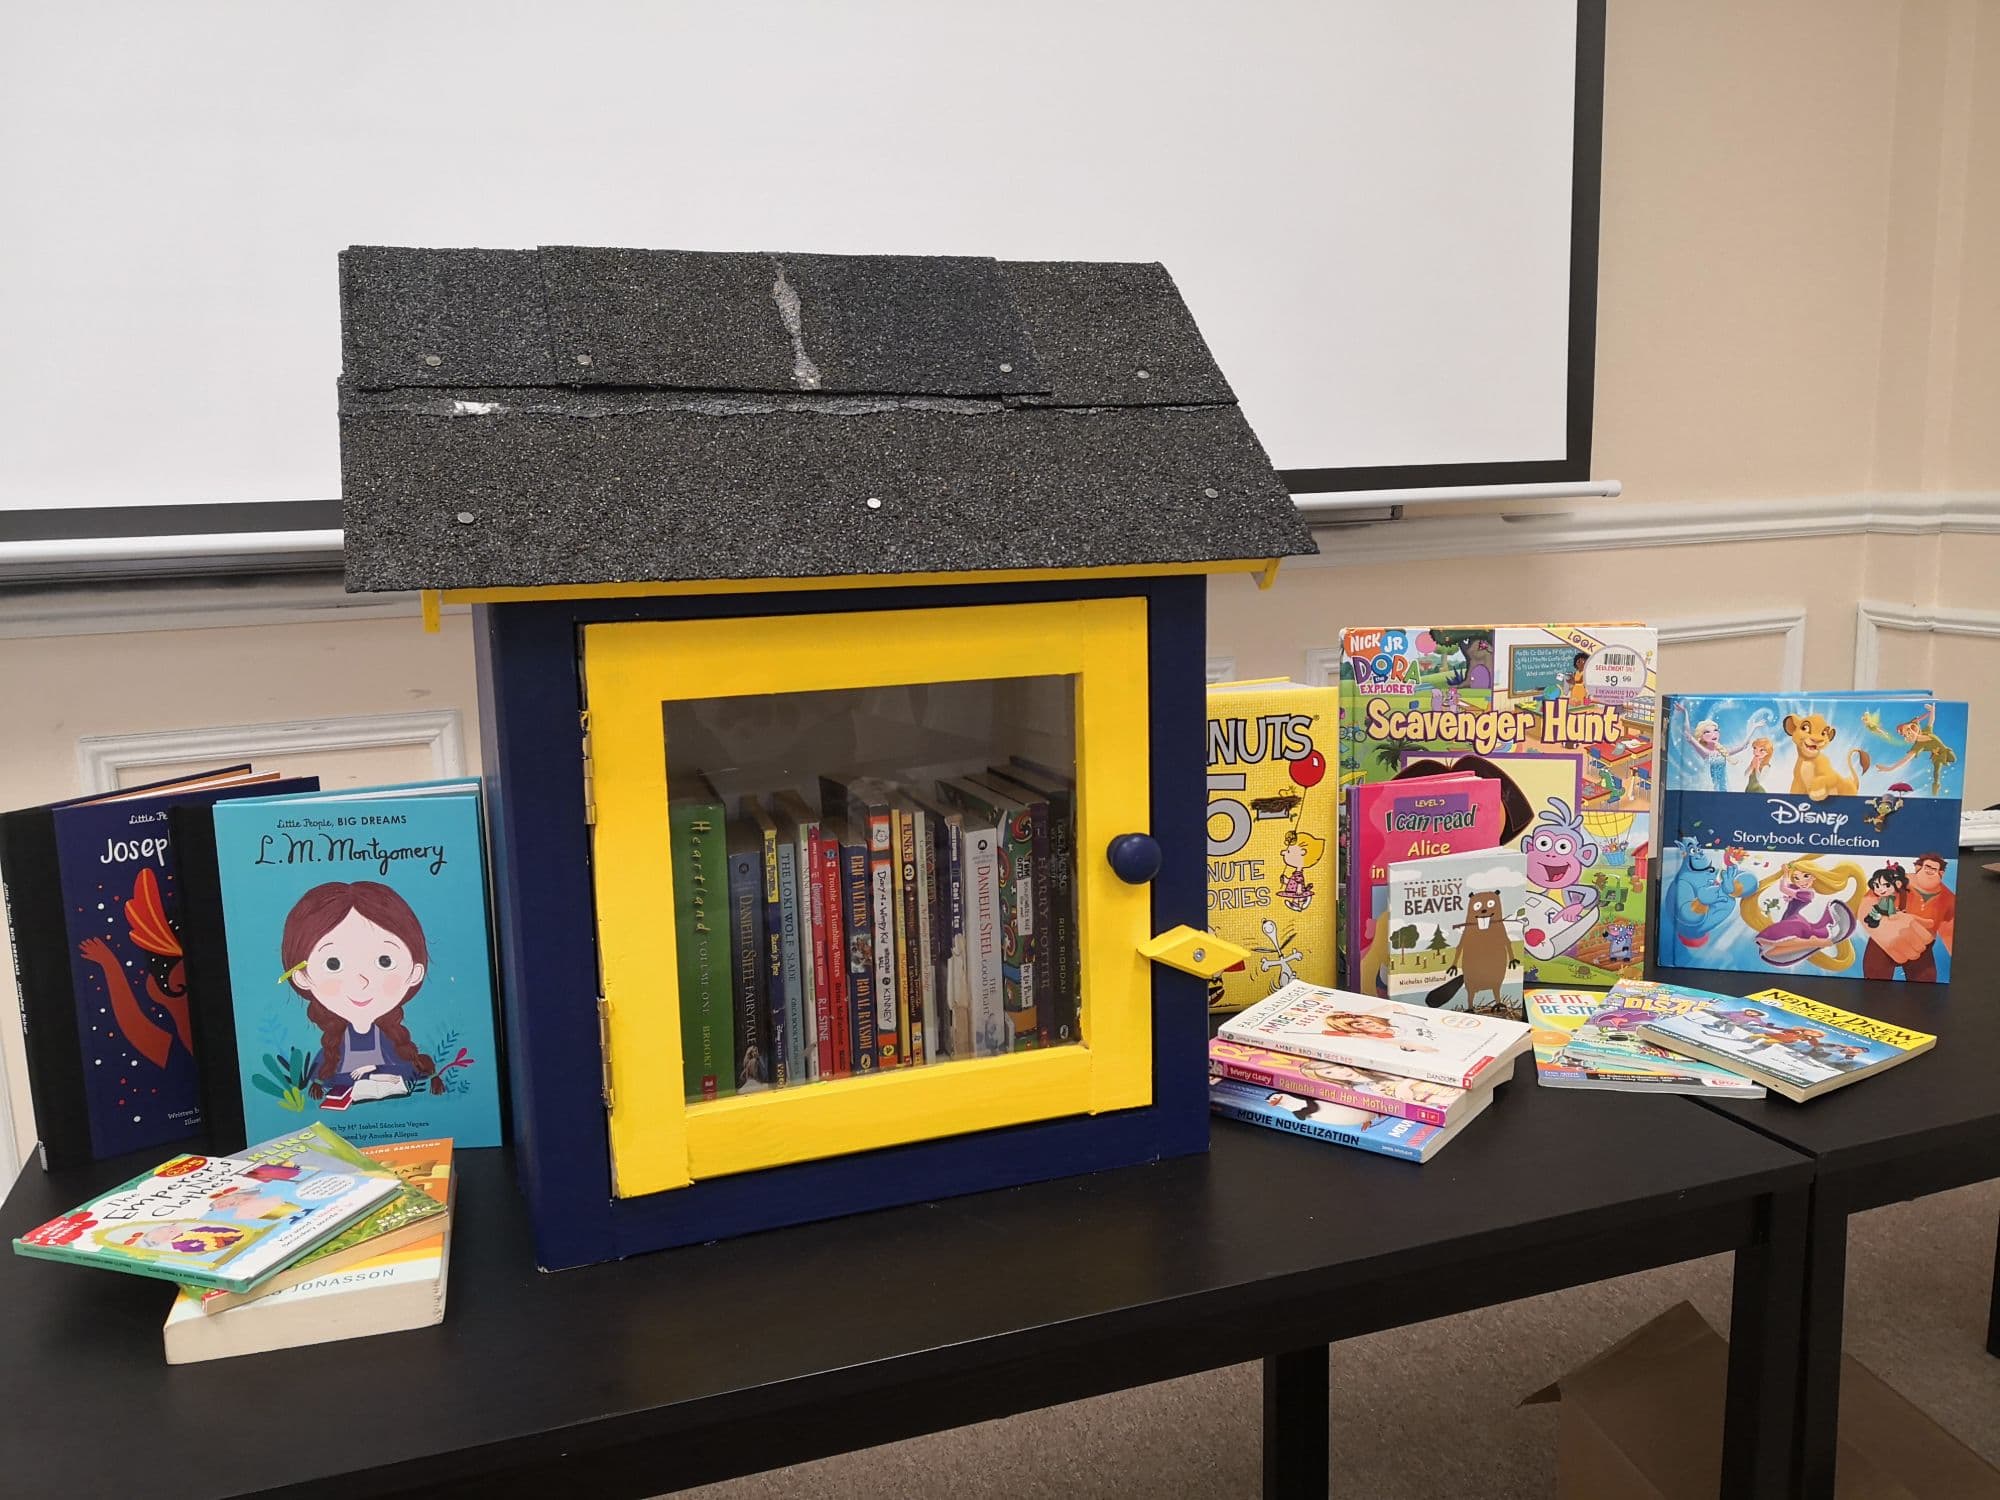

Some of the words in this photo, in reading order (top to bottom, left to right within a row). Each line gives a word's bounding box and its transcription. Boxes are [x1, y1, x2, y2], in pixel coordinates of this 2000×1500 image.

[1350, 633, 1381, 652] NICK
[1384, 636, 1404, 652] JR
[1567, 631, 1597, 652] LOOK
[1351, 653, 1421, 685] DORA
[1360, 684, 1414, 695] EXPLORER
[1207, 714, 1314, 766] NUTS
[1366, 697, 1536, 756] Scavenger
[1542, 698, 1623, 745] Hunt
[1385, 810, 1393, 832] I
[1396, 813, 1432, 832] can
[1433, 803, 1478, 833] read
[1415, 799, 1439, 808] LEVEL
[276, 819, 301, 829] Little
[303, 818, 335, 830] People,
[337, 817, 357, 826] BIG
[361, 815, 407, 825] DREAMS
[100, 838, 169, 867] Josep
[903, 823, 912, 859] FUNKE
[1407, 839, 1451, 857] Alice
[1733, 830, 1805, 846] Storybook
[1809, 833, 1880, 848] Collection
[319, 833, 448, 876] Montgomery
[781, 853, 791, 877] THE
[851, 855, 864, 878] ERIC
[691, 821, 712, 932] Heartland
[877, 871, 886, 893] Diary
[1207, 860, 1265, 883] NUTE
[1371, 865, 1385, 879] in
[783, 880, 792, 909] LOKI
[828, 873, 836, 902] Trouble
[977, 865, 992, 922] DANIELLE
[1039, 857, 1048, 919] HARRY
[1207, 887, 1271, 911] ORIES
[1404, 887, 1427, 900] THE
[1432, 883, 1463, 897] BUSY
[852, 879, 867, 928] WALTERS
[1404, 896, 1464, 916] BEAVER
[740, 895, 754, 950] DANIELLE
[784, 911, 794, 946] WOLF
[831, 914, 840, 951] Tumbling
[980, 923, 992, 957] STEEL
[742, 951, 757, 983] STEEL
[832, 952, 841, 978] Waters
[1040, 927, 1050, 988] POTTER
[856, 978, 869, 1010] ROYAL
[1399, 978, 1423, 986] Nicholas
[1424, 976, 1447, 984] Oldland
[745, 985, 757, 1043] FAIRYTALE
[884, 988, 892, 1023] KINNEY
[1533, 994, 1557, 1004] BE
[1560, 994, 1589, 1005] FIT,
[1540, 1005, 1561, 1014] BE
[819, 1016, 829, 1041] STINE
[858, 1011, 872, 1050] RANSOM
[1847, 1014, 1924, 1043] DREW
[702, 1025, 712, 1068] BROOKE
[1299, 1049, 1322, 1058] BRON
[1279, 1079, 1315, 1095] Ramona
[1320, 1088, 1337, 1098] and
[1340, 1093, 1358, 1105] Her
[168, 1109, 193, 1120] Written
[1236, 1109, 1272, 1126] MOVIE
[1275, 1117, 1361, 1147] NOVELIZATION
[248, 1130, 318, 1162] KLING
[103, 1159, 232, 1221] Emperor's
[187, 1166, 232, 1189] New
[151, 1178, 233, 1218] Clothes
[291, 1268, 395, 1293] JONASSON
